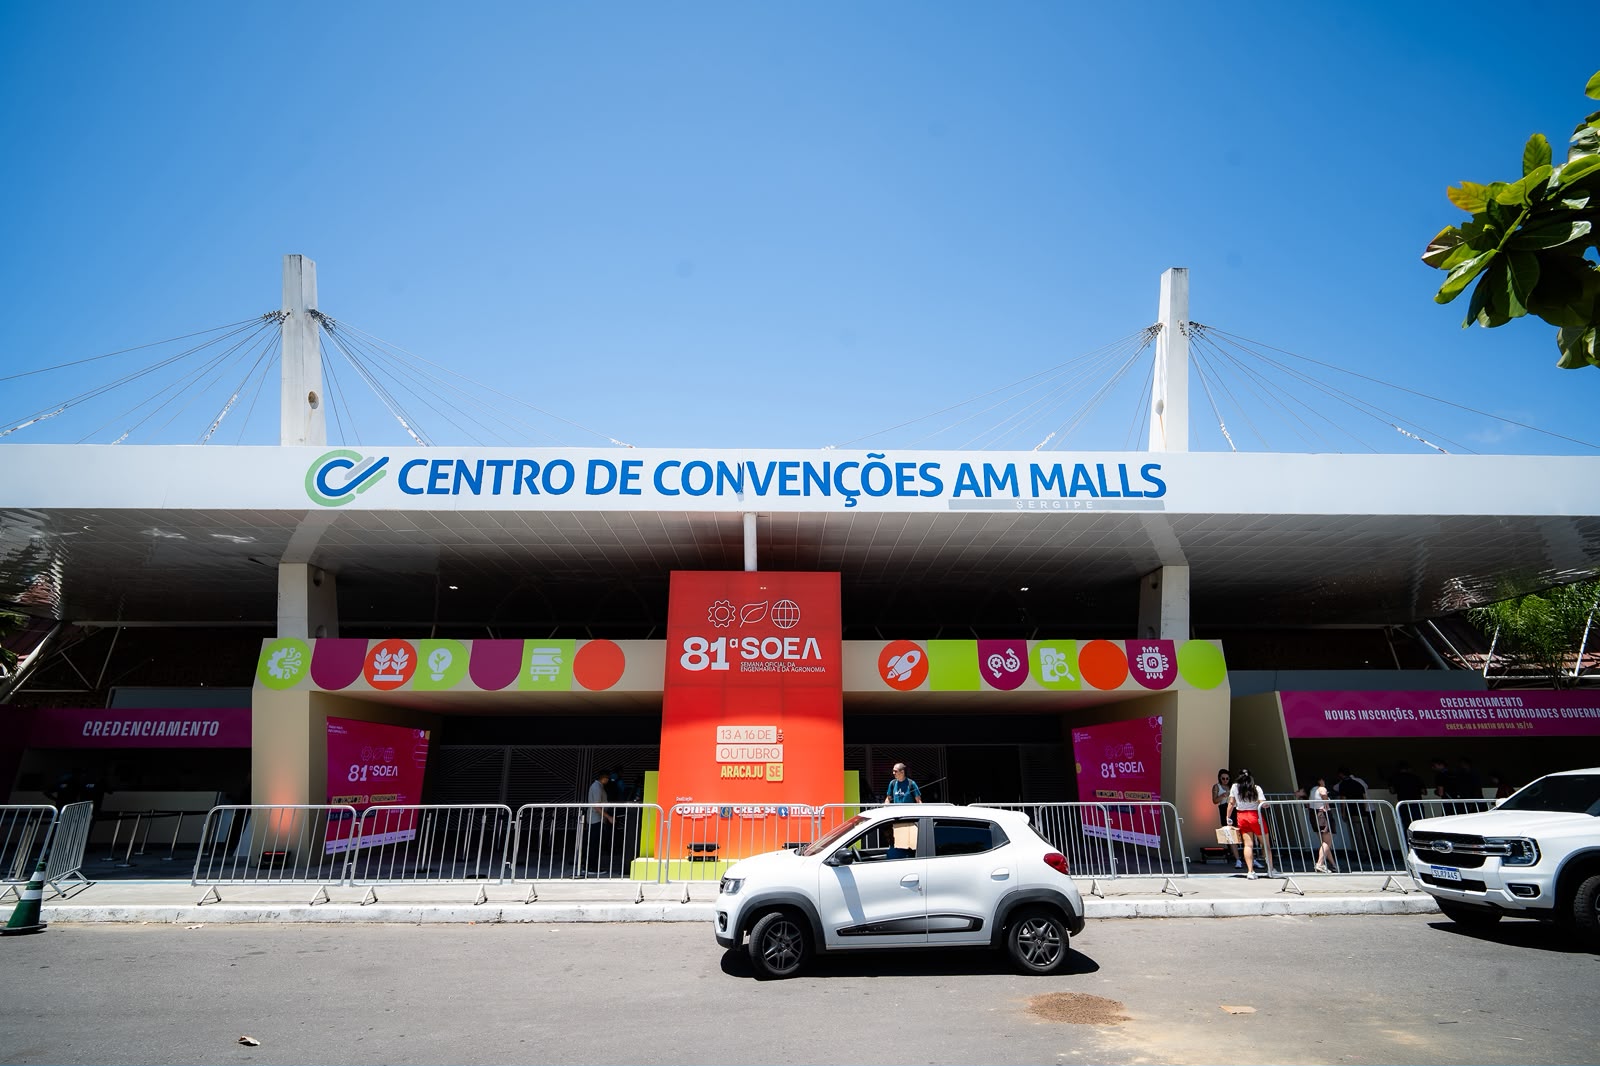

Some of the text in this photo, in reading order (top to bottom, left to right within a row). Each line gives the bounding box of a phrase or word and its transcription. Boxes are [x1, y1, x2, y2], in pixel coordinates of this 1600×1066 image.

[398, 453, 1167, 507] CENTRO DE CONVENÇÕES AM MALLS
[1016, 500, 1094, 510] SERGIPE
[1440, 697, 1523, 708] CREDENCIAMENTO
[1324, 709, 1356, 721] NOVAS
[1358, 707, 1418, 722] INSCRIÇÕES,
[1419, 708, 1488, 720] PALESTRANTES
[1489, 708, 1495, 719] E
[1497, 708, 1559, 719] AUTORIDADES
[82, 720, 220, 737] CREDENCIAMENTO
[721, 729, 772, 740] 13 A 16 DE
[720, 747, 780, 759] OUTUBRO
[720, 765, 781, 778] ARACAJU SE
